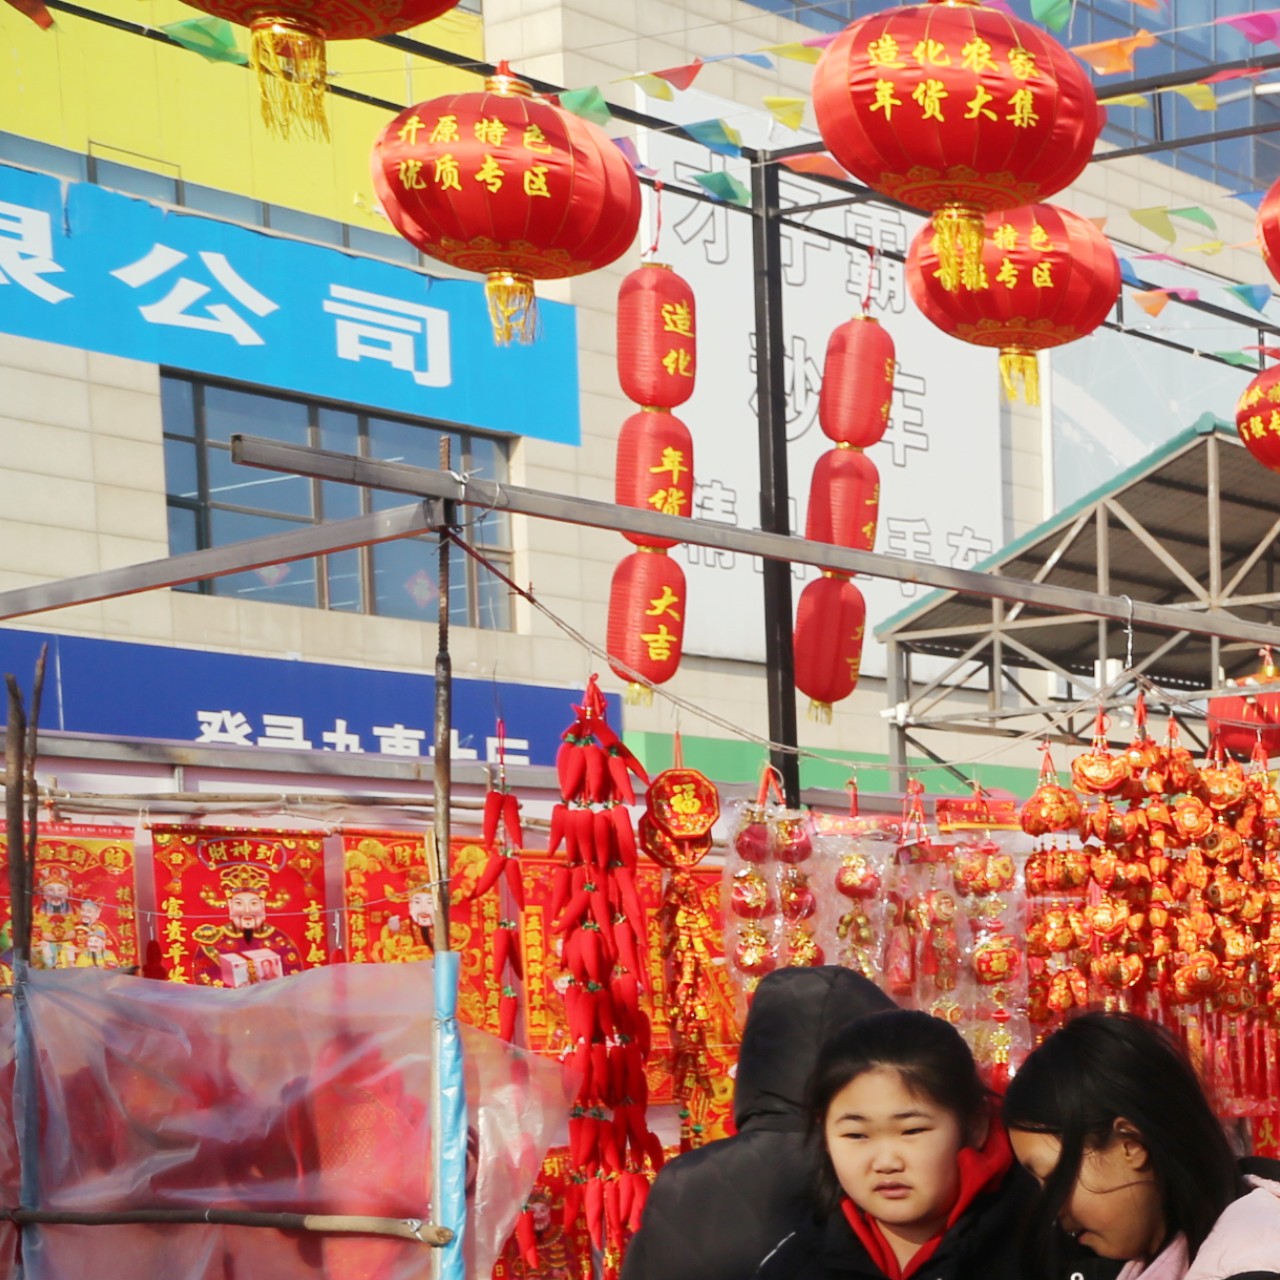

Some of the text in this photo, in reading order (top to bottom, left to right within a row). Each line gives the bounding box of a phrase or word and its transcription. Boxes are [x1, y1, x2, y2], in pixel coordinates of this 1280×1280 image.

[868, 34, 1040, 80] 造化农家
[869, 78, 1040, 128] 年货大集
[398, 115, 552, 154] 开原特色
[398, 154, 551, 198] 优质专区
[660, 301, 695, 377] 造化
[642, 586, 681, 662] 大吉
[669, 783, 701, 814] 福
[208, 840, 277, 865] 財神到
[303, 900, 326, 968] 吉祥如
